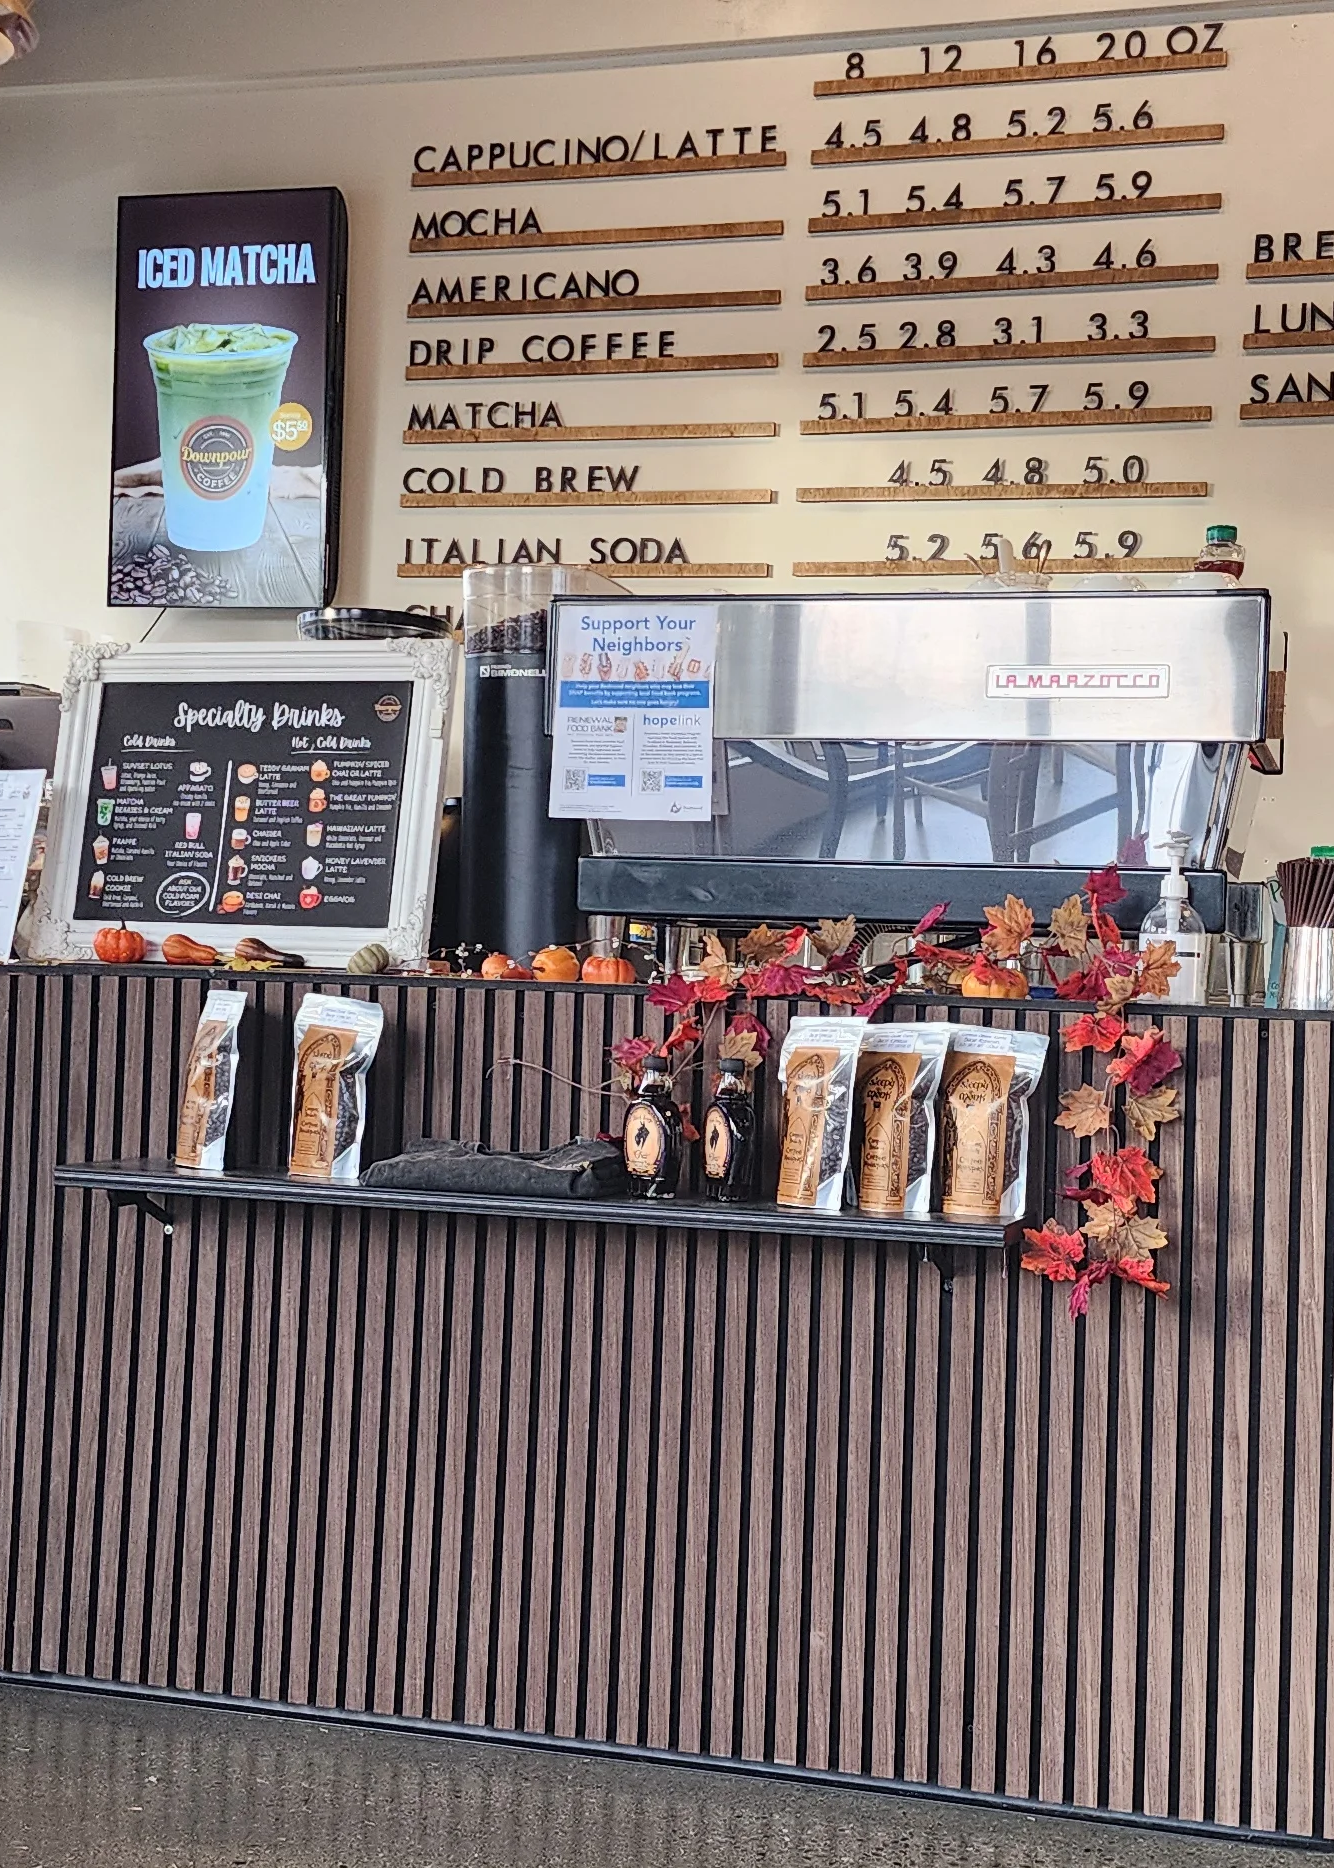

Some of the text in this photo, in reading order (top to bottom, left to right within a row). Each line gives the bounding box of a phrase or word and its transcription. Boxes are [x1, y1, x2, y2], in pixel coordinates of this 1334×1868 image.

[845, 23, 1224, 80] 8 12 16 20 OZ
[825, 100, 1154, 149] 4.5 4.8 5.2 5.6
[413, 125, 778, 173] CAPPUCINO/LATTE
[822, 170, 1153, 217] 5.1 5.4 5.7 5.9
[411, 207, 543, 240] MOCHA
[137, 243, 316, 289] ICED MATCHA
[820, 238, 1157, 285] 3.6 3.9 4.3 4.6
[411, 269, 640, 306] AMERICANO
[817, 310, 1150, 353] 2.5 2.8 3.1 3.3
[409, 331, 676, 367] DRIP COFFEE
[407, 401, 564, 431] MATCHA
[818, 380, 1150, 421] 5.1 5.4 5.7 5.9
[181, 445, 252, 468] Downpour
[887, 455, 1145, 487] 4.5 4.8 5.0
[196, 472, 237, 488] COFFEE
[403, 465, 640, 494] COLD BREW
[404, 537, 689, 566] ITALIAN SODA
[885, 530, 1143, 562] 5.2 56 5.9
[581, 615, 696, 634] Support Your
[593, 636, 683, 656] Neighbors
[174, 699, 345, 732] Specialty Drinks
[567, 724, 613, 733] FOOD BANK
[643, 714, 701, 729] hopelink
[123, 734, 176, 747] Cold Drinks
[291, 735, 371, 749] Hot Cold Drinks
[360, 770, 382, 778] LATTE
